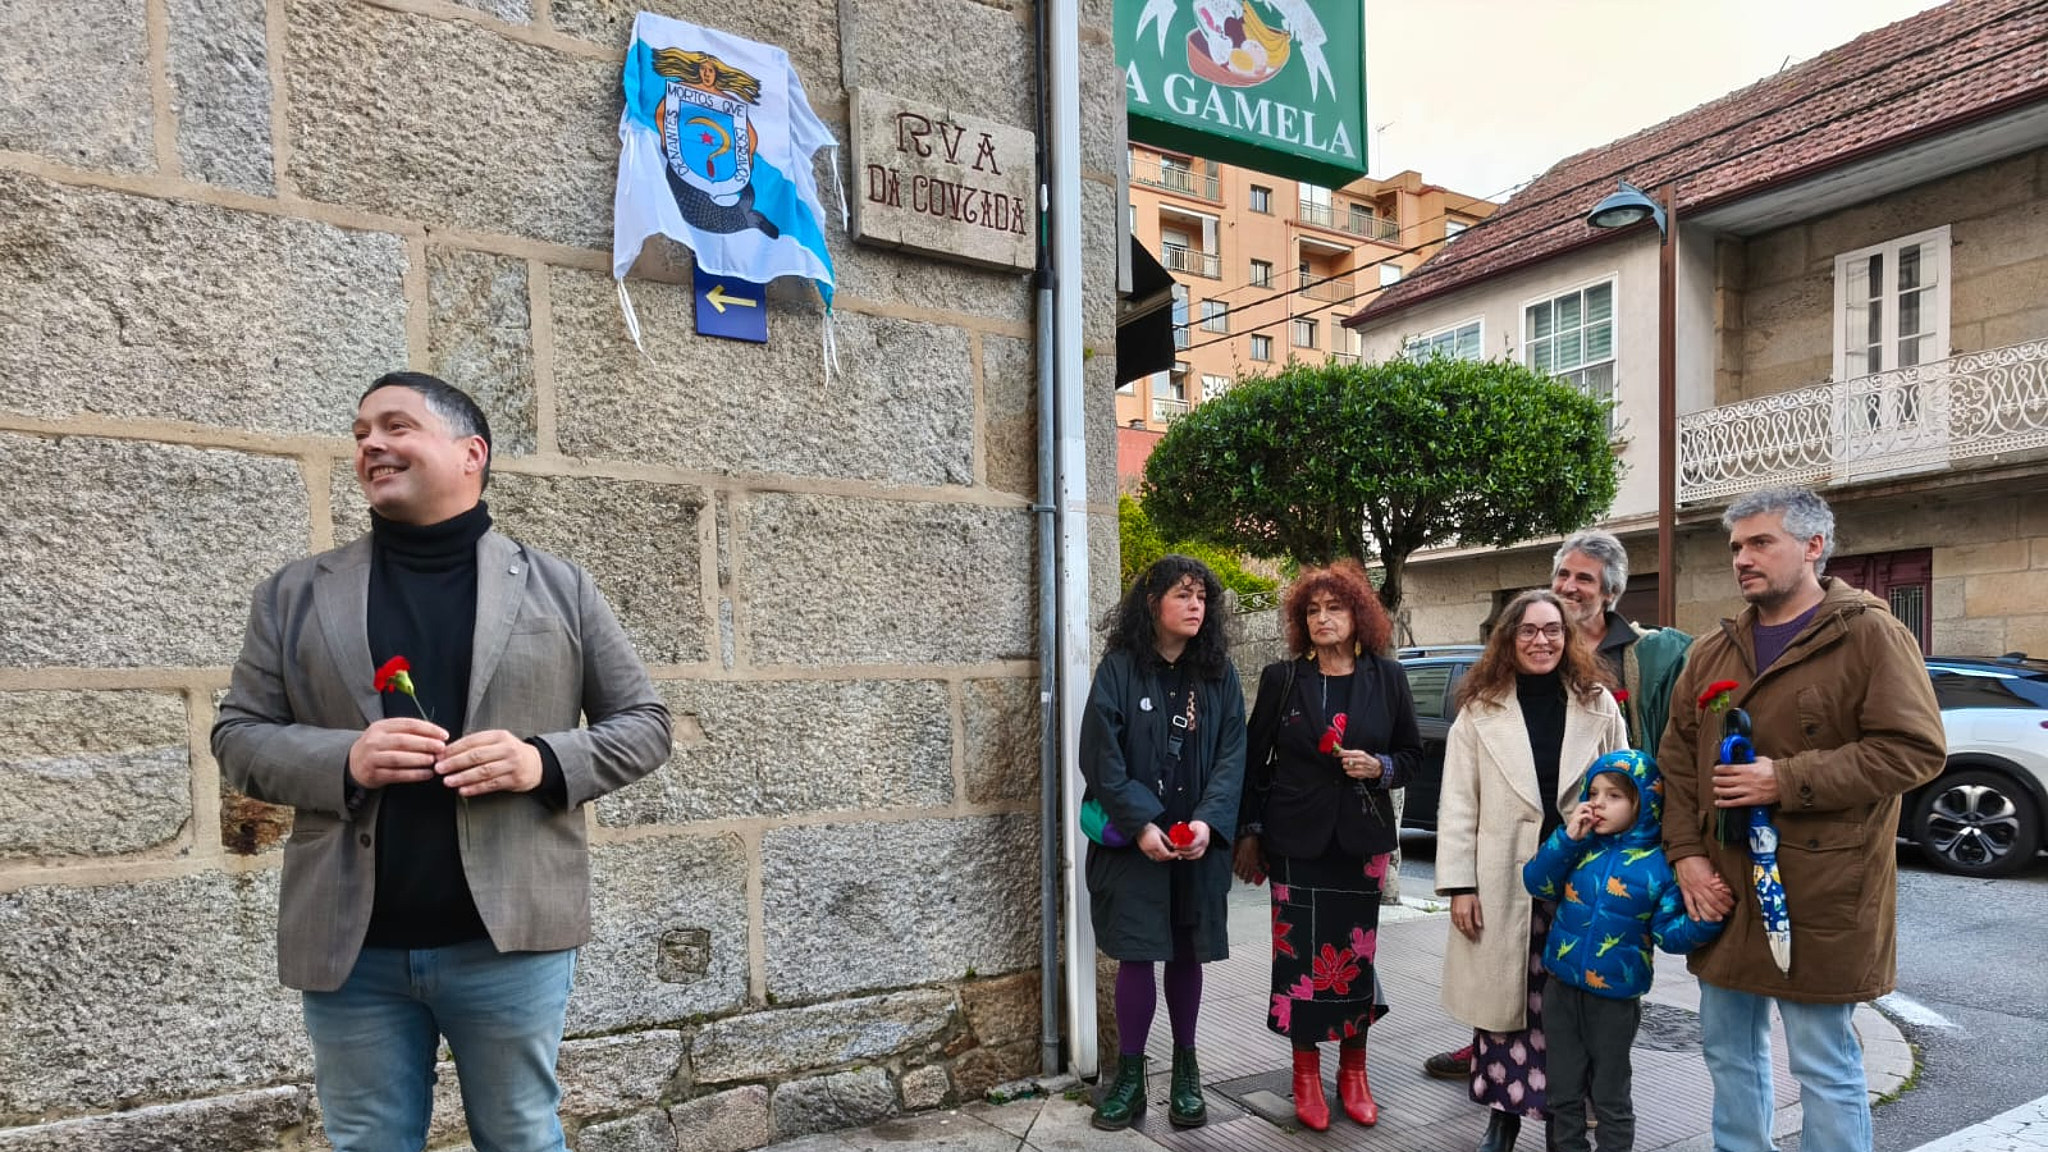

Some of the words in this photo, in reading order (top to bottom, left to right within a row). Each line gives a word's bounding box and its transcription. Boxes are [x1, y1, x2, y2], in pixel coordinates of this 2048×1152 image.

[668, 83, 713, 107] MORTOS
[1163, 73, 1356, 159] GAMELA
[666, 109, 689, 176] DENANTES
[867, 164, 902, 209] DA
